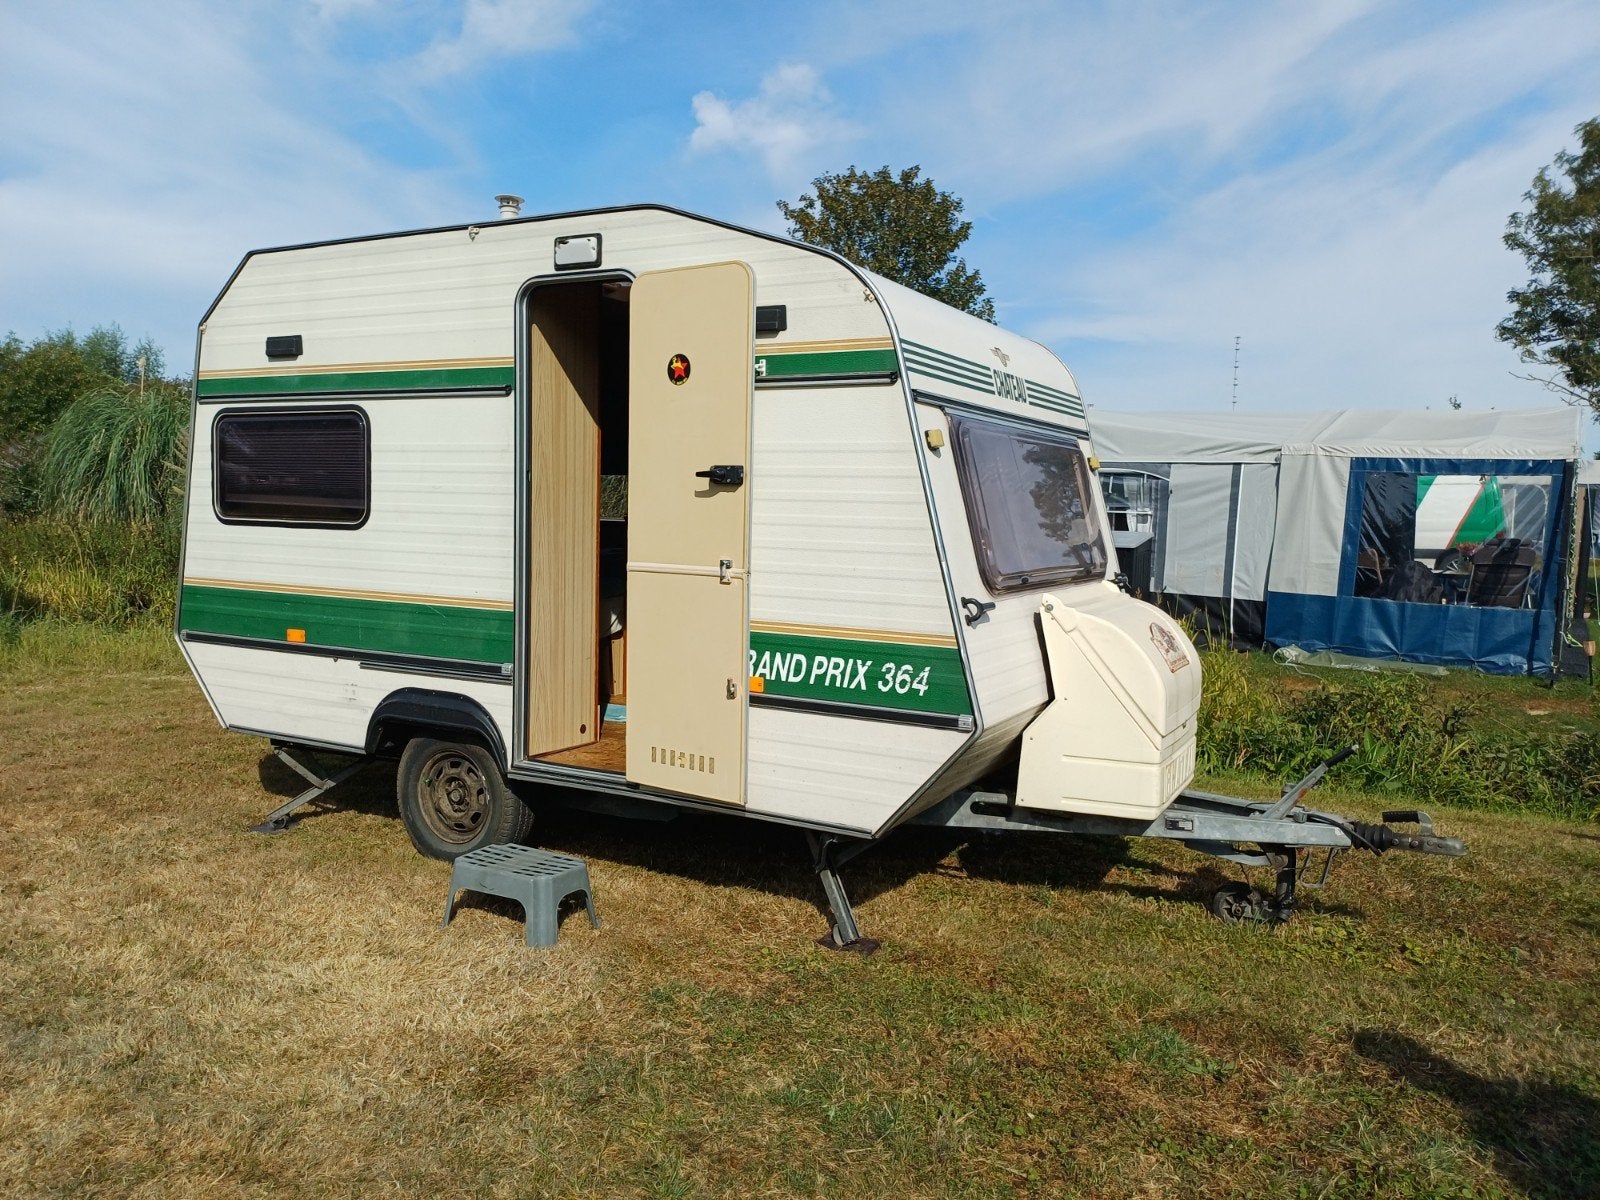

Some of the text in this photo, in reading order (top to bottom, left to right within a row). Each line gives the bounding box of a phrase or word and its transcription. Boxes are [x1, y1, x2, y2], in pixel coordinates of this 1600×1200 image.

[993, 369, 1027, 403] CHATEAU
[809, 656, 872, 690] PRIX
[877, 662, 931, 696] 364
